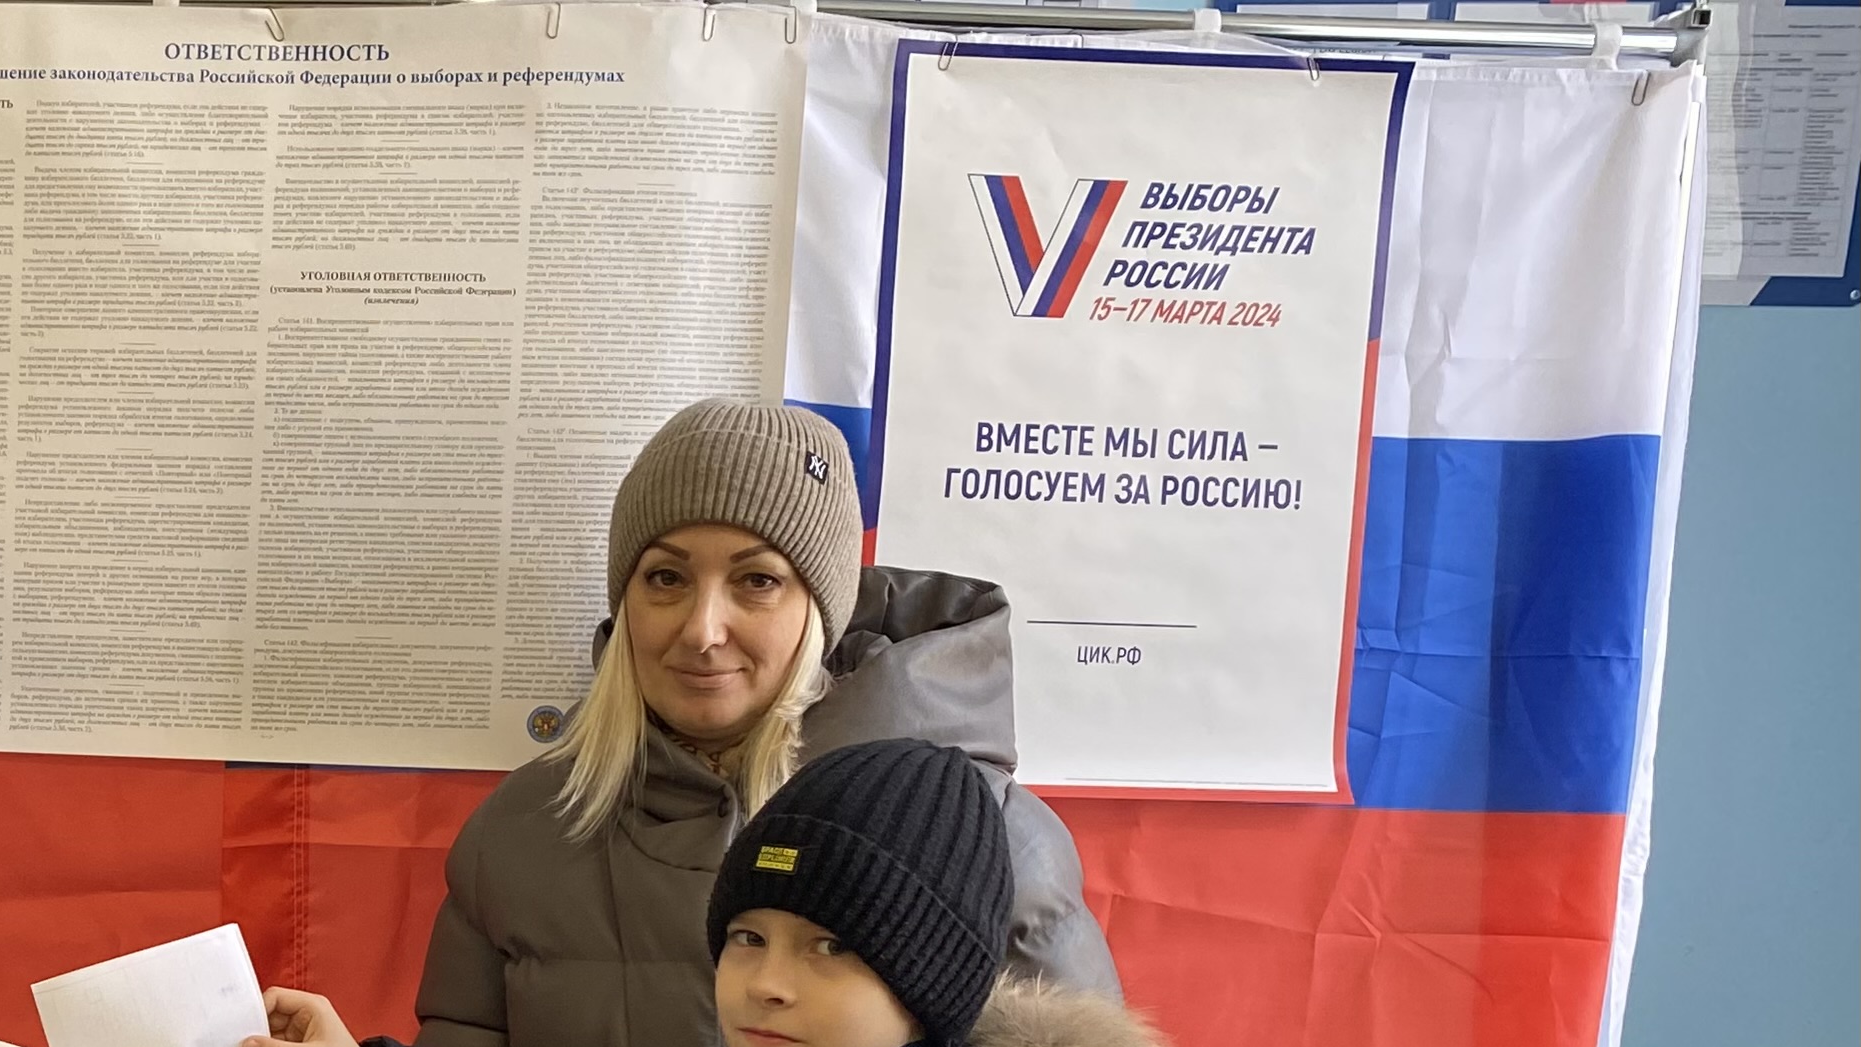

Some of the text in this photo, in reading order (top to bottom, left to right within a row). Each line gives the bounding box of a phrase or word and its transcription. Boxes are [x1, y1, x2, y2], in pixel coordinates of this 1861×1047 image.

[164, 42, 390, 62] ОТВЕТСТВЕННОСТЬ
[49, 69, 195, 85] законодательства
[198, 69, 295, 84] Российской
[299, 70, 392, 88] Федерации
[396, 72, 406, 84] о
[411, 69, 482, 87] выборах
[488, 71, 498, 83] и
[502, 67, 625, 88] референдумах
[1139, 182, 1281, 214] ВЫБОРЫ
[1121, 221, 1317, 256] ПРЕЗИДЕНТА
[300, 270, 485, 282] УГОЛОВНАЯ ОТВЕТСТВЕННОСТЬ
[1103, 260, 1231, 291] РОССИИ
[1152, 300, 1223, 326] МАРТА
[1227, 303, 1283, 328] 2024
[975, 423, 1095, 455] ВМЕСТЕ
[1104, 427, 1158, 458] МЫ
[1167, 430, 1249, 462] СИЛА
[944, 468, 1302, 511] ГОЛОСУЕМ ЗА РОССИЮ!
[1076, 645, 1142, 666] ЦИК.РФ
